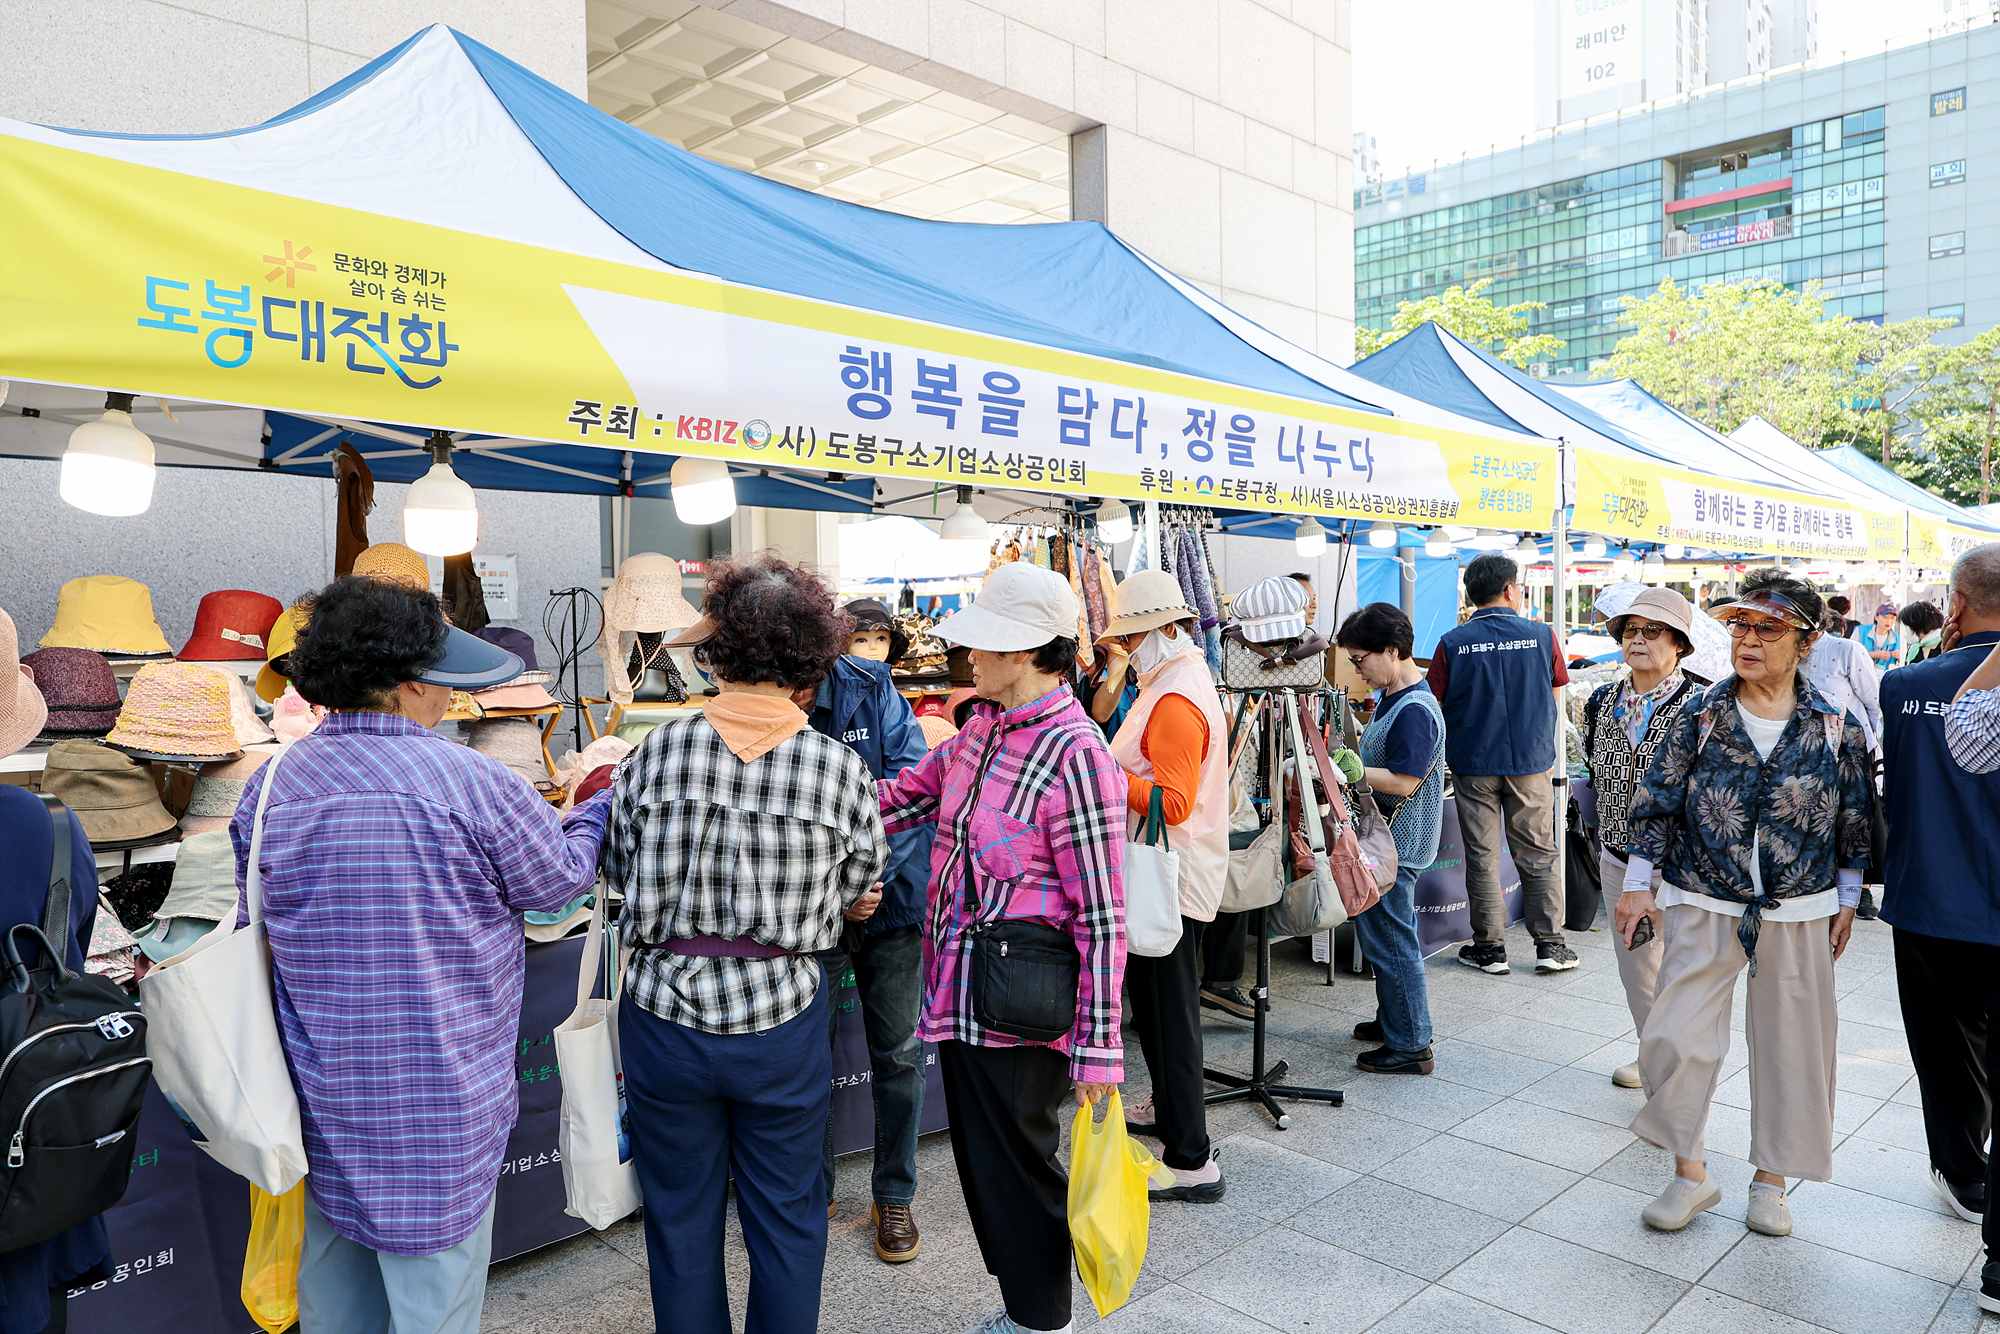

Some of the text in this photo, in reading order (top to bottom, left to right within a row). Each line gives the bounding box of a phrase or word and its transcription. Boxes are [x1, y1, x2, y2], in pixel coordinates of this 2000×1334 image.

[1575, 23, 1627, 49] 래미안
[1585, 62, 1615, 82] 102
[1934, 96, 1963, 115] 발레
[1932, 162, 1963, 178] 교회
[1737, 227, 1774, 243] 마사지
[332, 253, 448, 290] 문화와 경제가
[349, 277, 448, 312] 살아 숨 쉬는
[137, 275, 460, 390] 도봉대전환
[838, 343, 1028, 439] 행복을
[1277, 425, 1376, 483] 나누다
[567, 398, 640, 441] 주최
[777, 425, 817, 460] 사)
[824, 432, 1088, 488] 도봉구소기업소상공인회
[1470, 455, 1541, 481] 도봉구소상공인
[1140, 467, 1174, 495] 후원
[1219, 477, 1284, 508] 도봉구청,
[1478, 487, 1533, 514] 행복응원장터
[1694, 489, 1747, 527] 함께하는
[1835, 512, 1853, 540] 행복
[1657, 524, 1670, 540] 주최
[1705, 531, 1764, 549] 도봉구소기업소상공인회
[679, 559, 700, 574] 1991
[1527, 568, 1554, 579] 소상
[1458, 638, 1537, 655] 사) 도봉구 소상공인회
[1901, 699, 1920, 715] 사)
[1412, 901, 1467, 914] 구소기업소상공인회
[831, 1070, 874, 1089] 구소기
